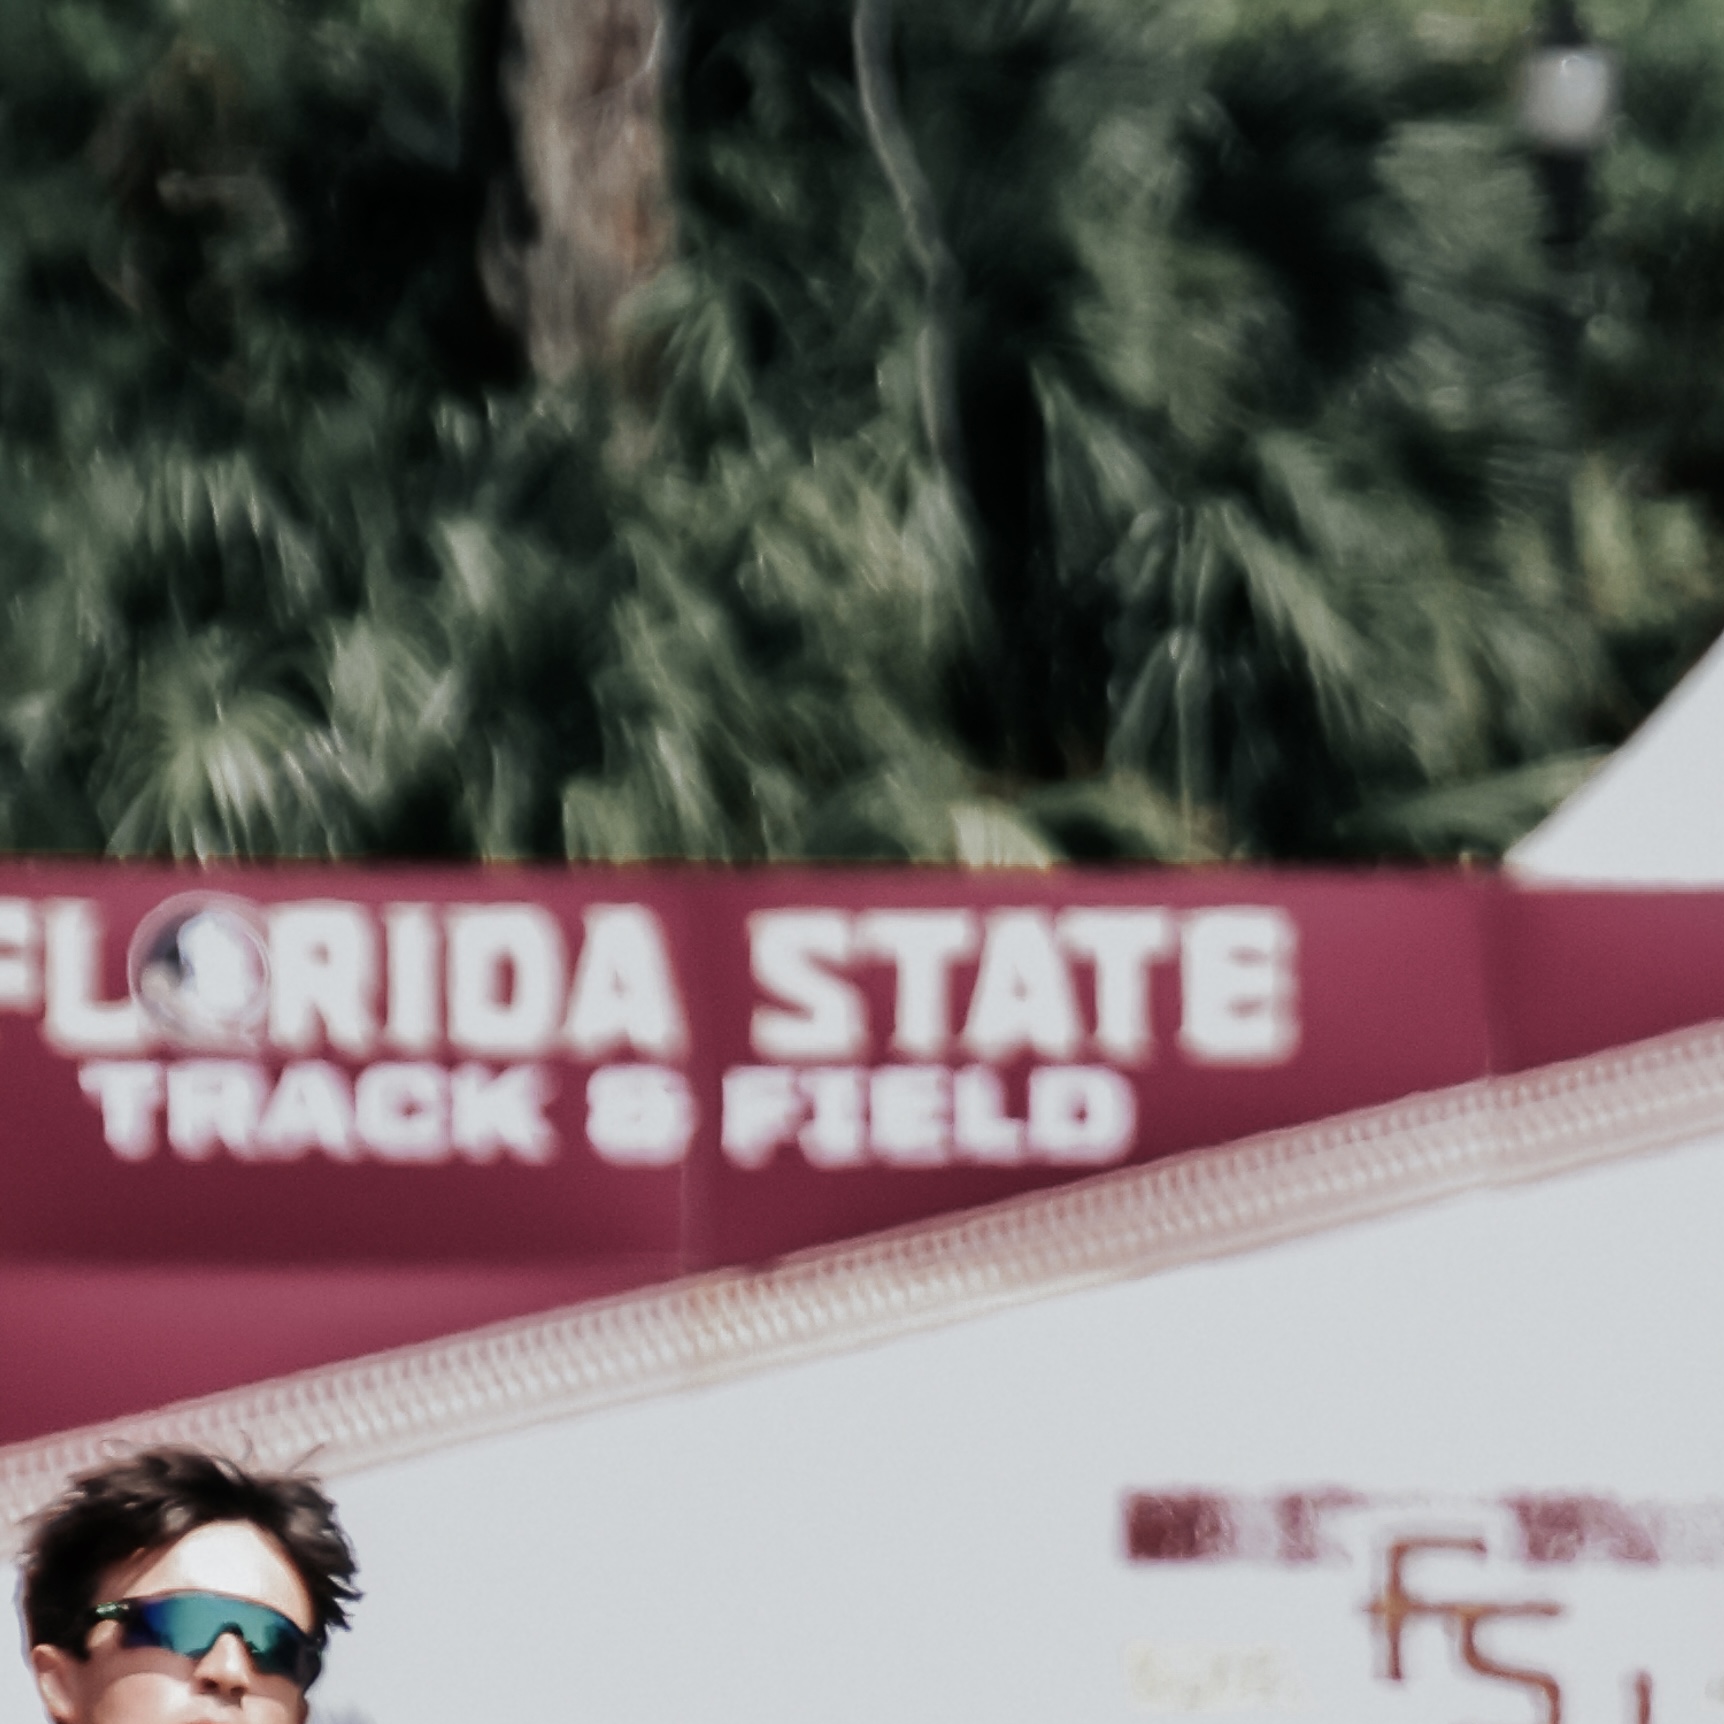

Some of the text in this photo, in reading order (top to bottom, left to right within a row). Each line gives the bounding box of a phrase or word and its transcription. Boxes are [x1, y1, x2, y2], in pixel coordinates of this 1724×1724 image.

[743, 906, 1302, 1066] STATE
[78, 1058, 558, 1166] TRACK
[720, 1063, 1137, 1168] FIELD
